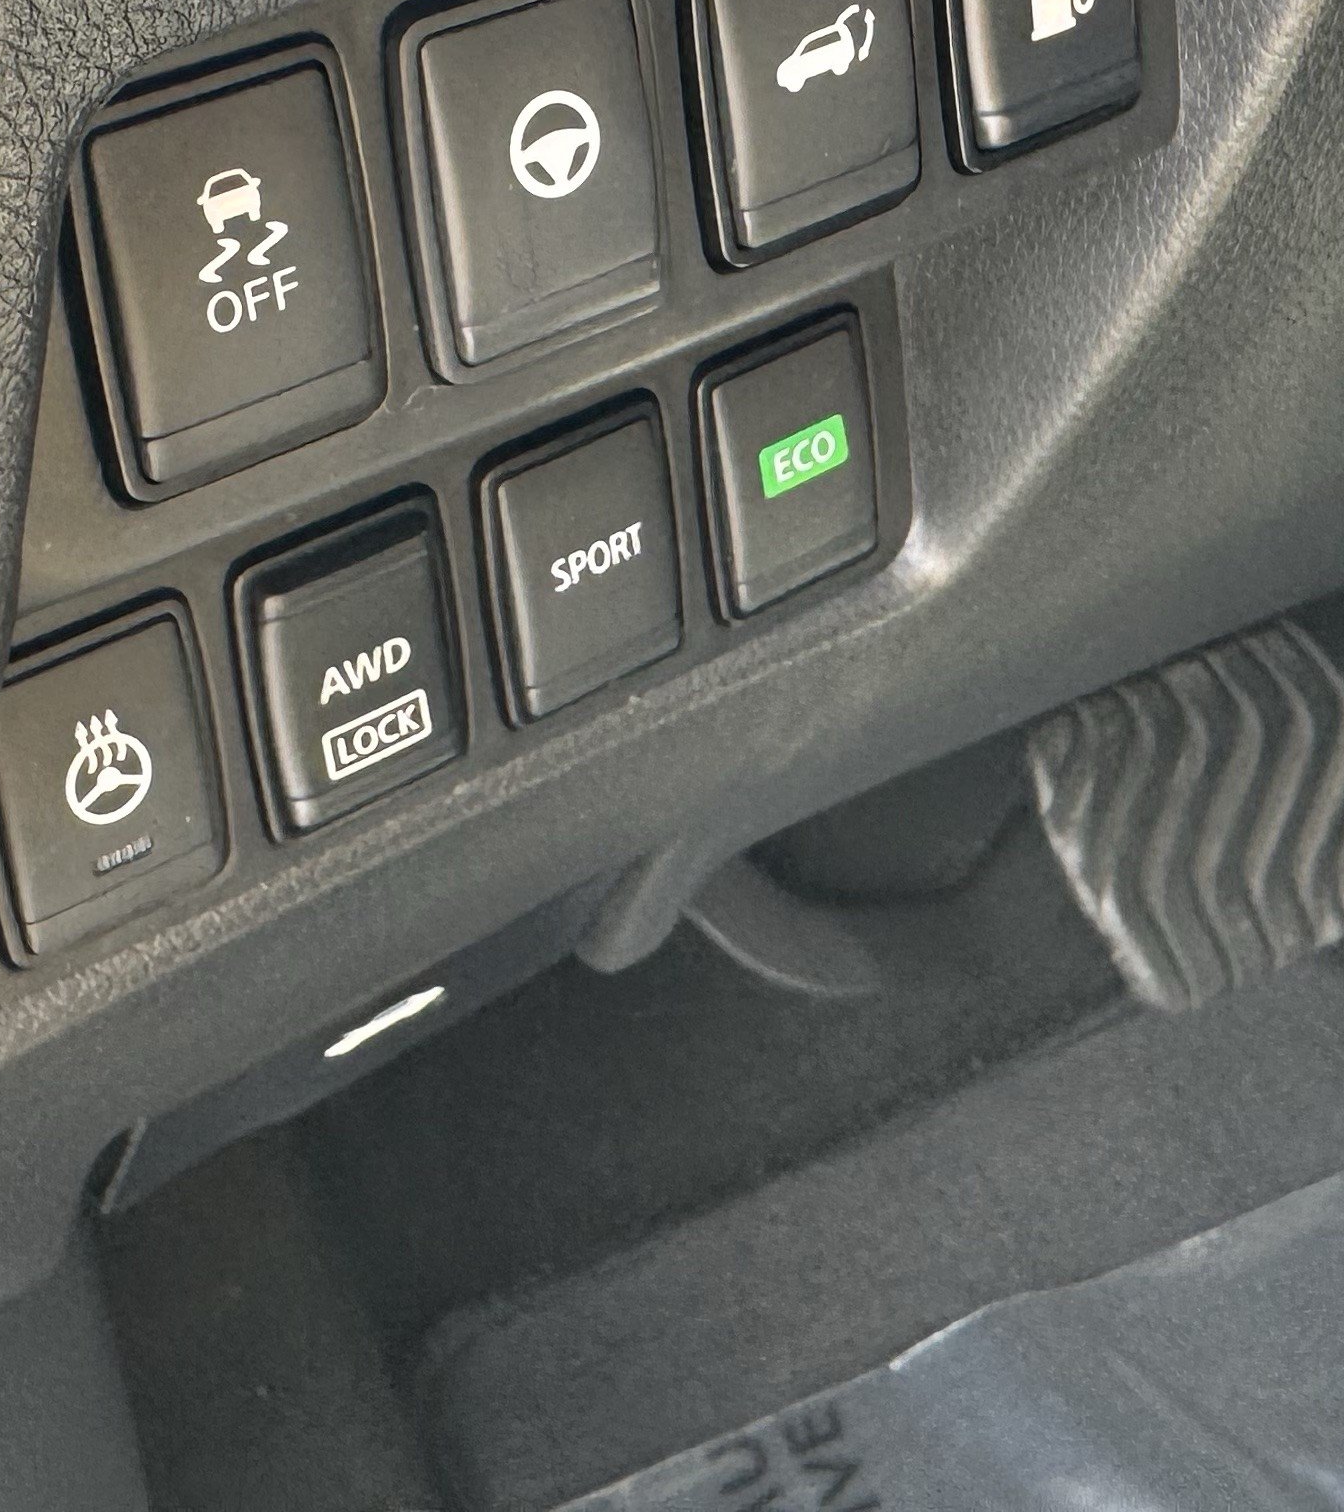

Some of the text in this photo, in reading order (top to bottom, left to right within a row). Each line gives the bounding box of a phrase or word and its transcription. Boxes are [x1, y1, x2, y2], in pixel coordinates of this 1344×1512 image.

[206, 265, 299, 333] OFF
[773, 430, 836, 483] ECO
[550, 521, 642, 593] SPORT
[320, 637, 412, 706] AWD
[336, 704, 421, 765] LOCK
